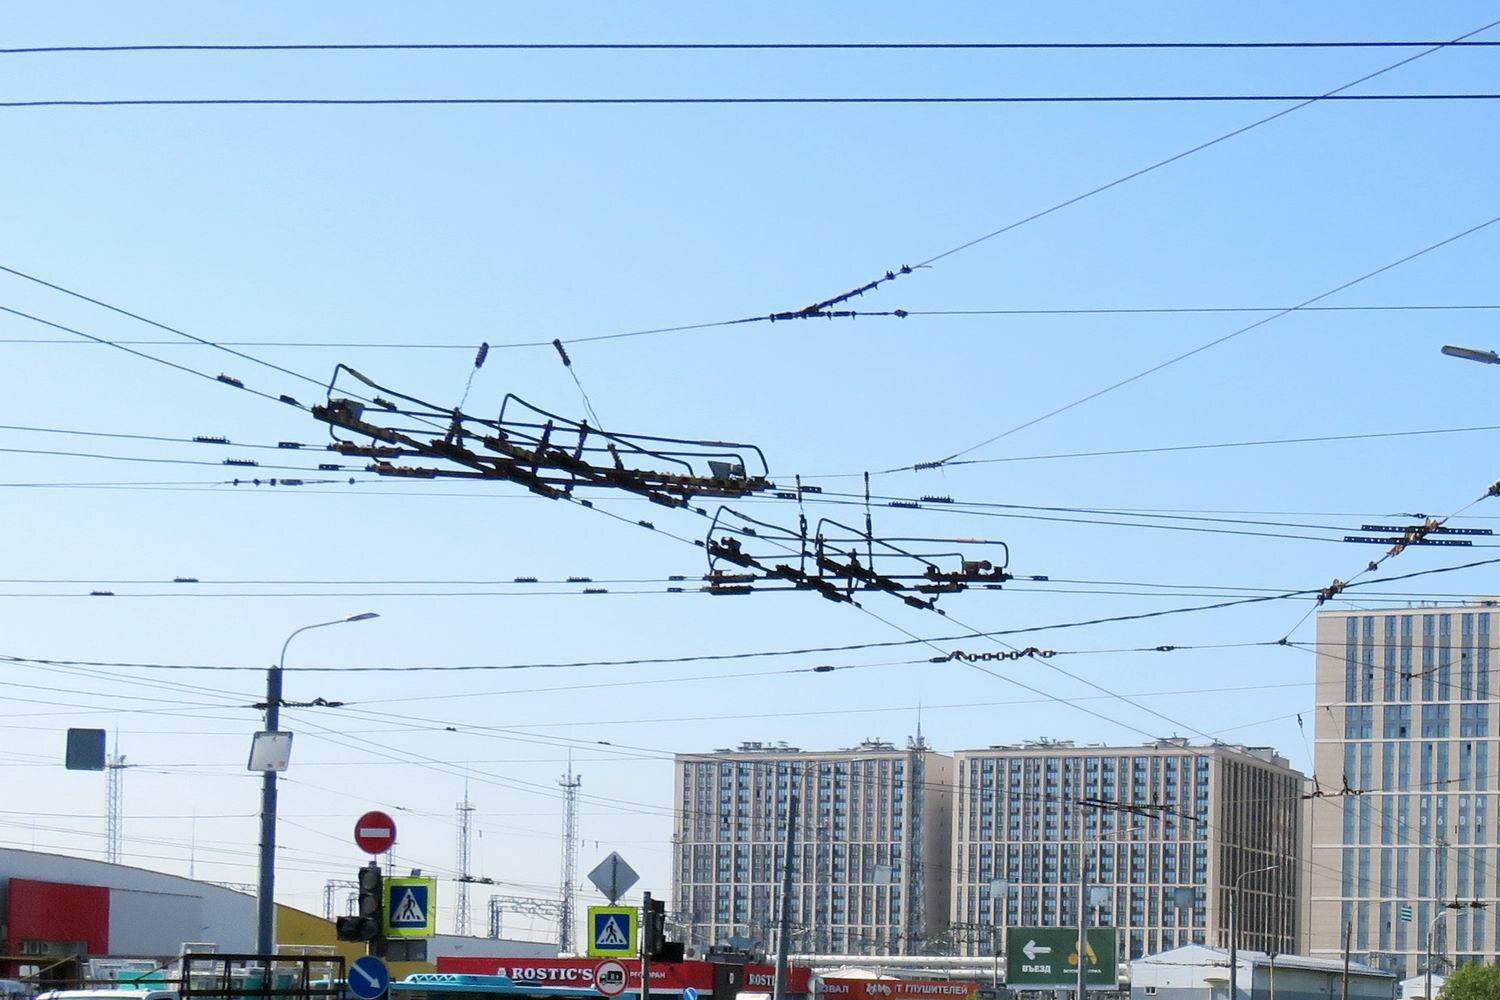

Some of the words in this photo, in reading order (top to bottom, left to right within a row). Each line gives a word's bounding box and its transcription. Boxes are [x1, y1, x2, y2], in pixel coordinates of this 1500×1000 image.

[511, 966, 594, 981] ROSTIC'S
[1021, 964, 1052, 974] ВЪЕЗД
[905, 984, 968, 995] ГЛУШИТЕЛЕЙ
